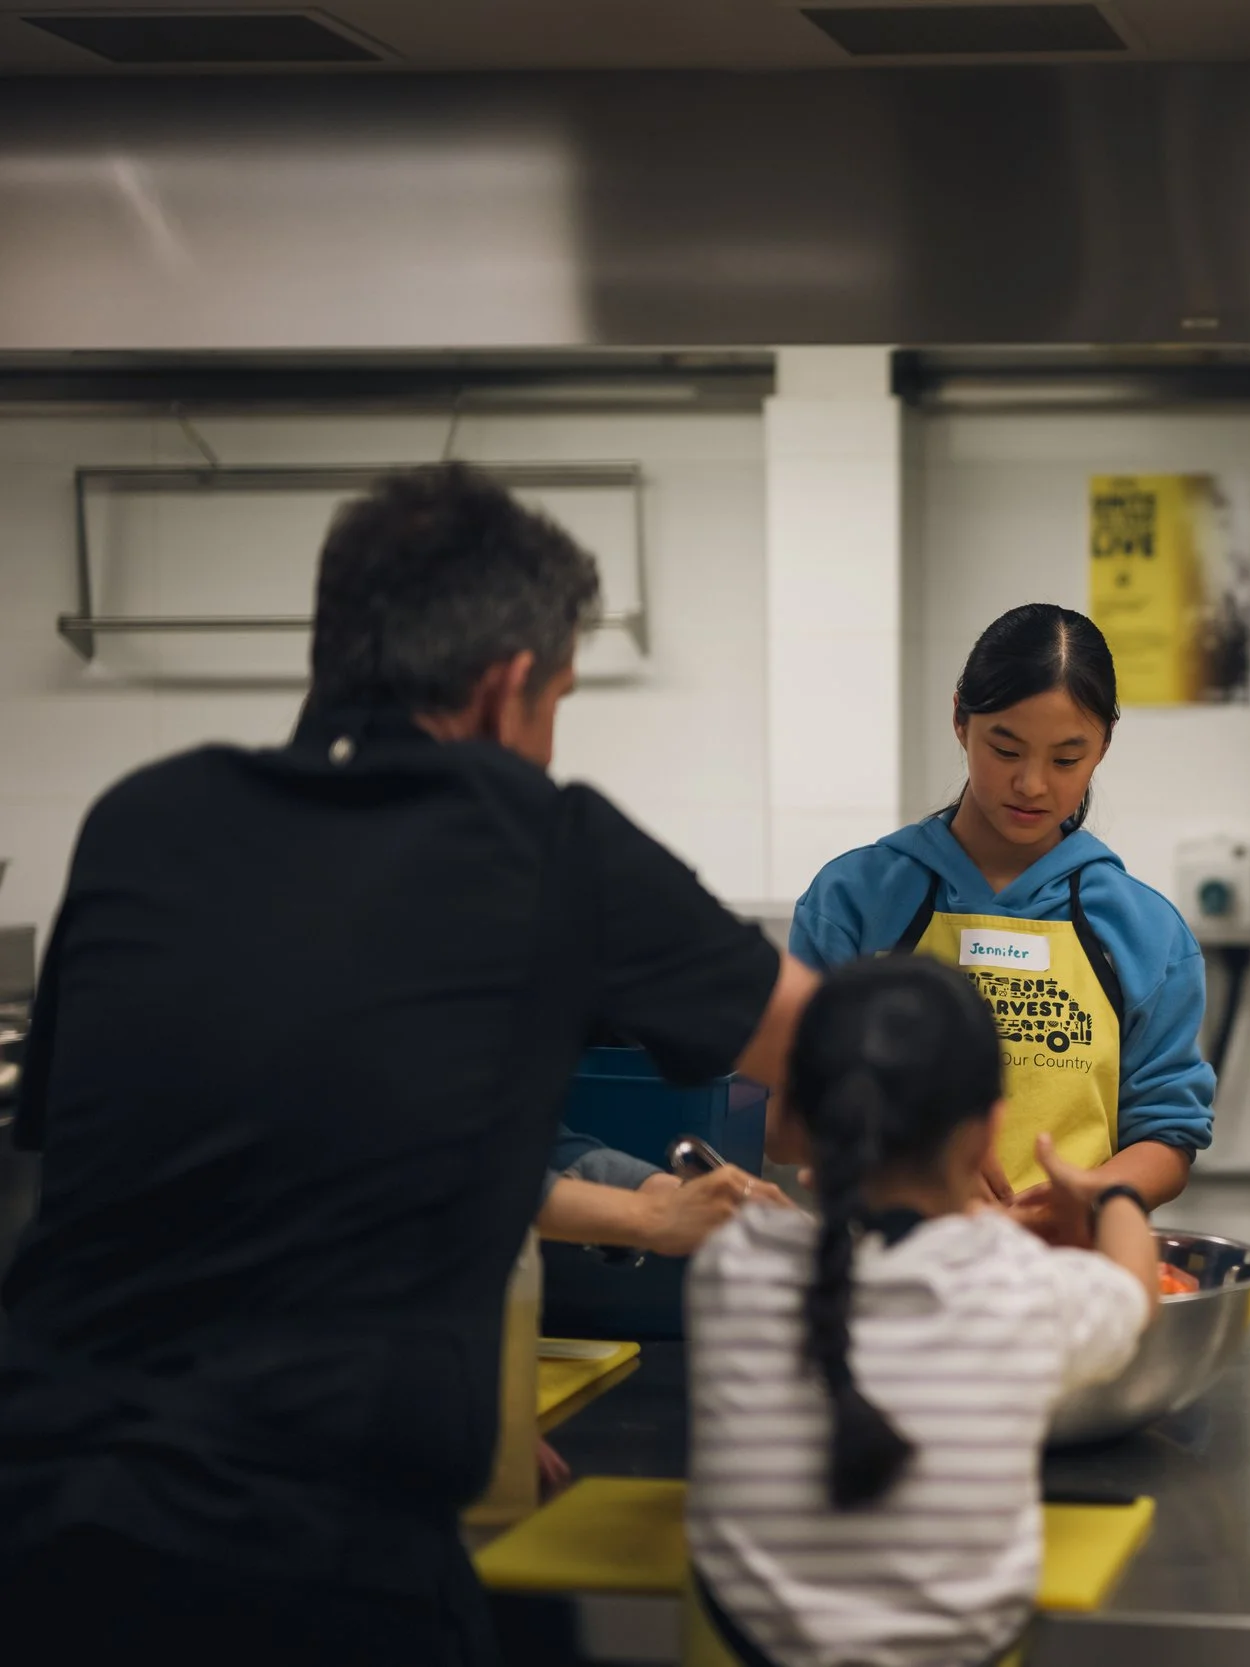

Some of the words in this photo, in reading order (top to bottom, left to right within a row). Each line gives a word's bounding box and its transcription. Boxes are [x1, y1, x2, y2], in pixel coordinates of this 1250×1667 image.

[969, 942, 1030, 959] Jennifer
[1003, 1052, 1029, 1067] Our
[1033, 1053, 1093, 1074] Country
